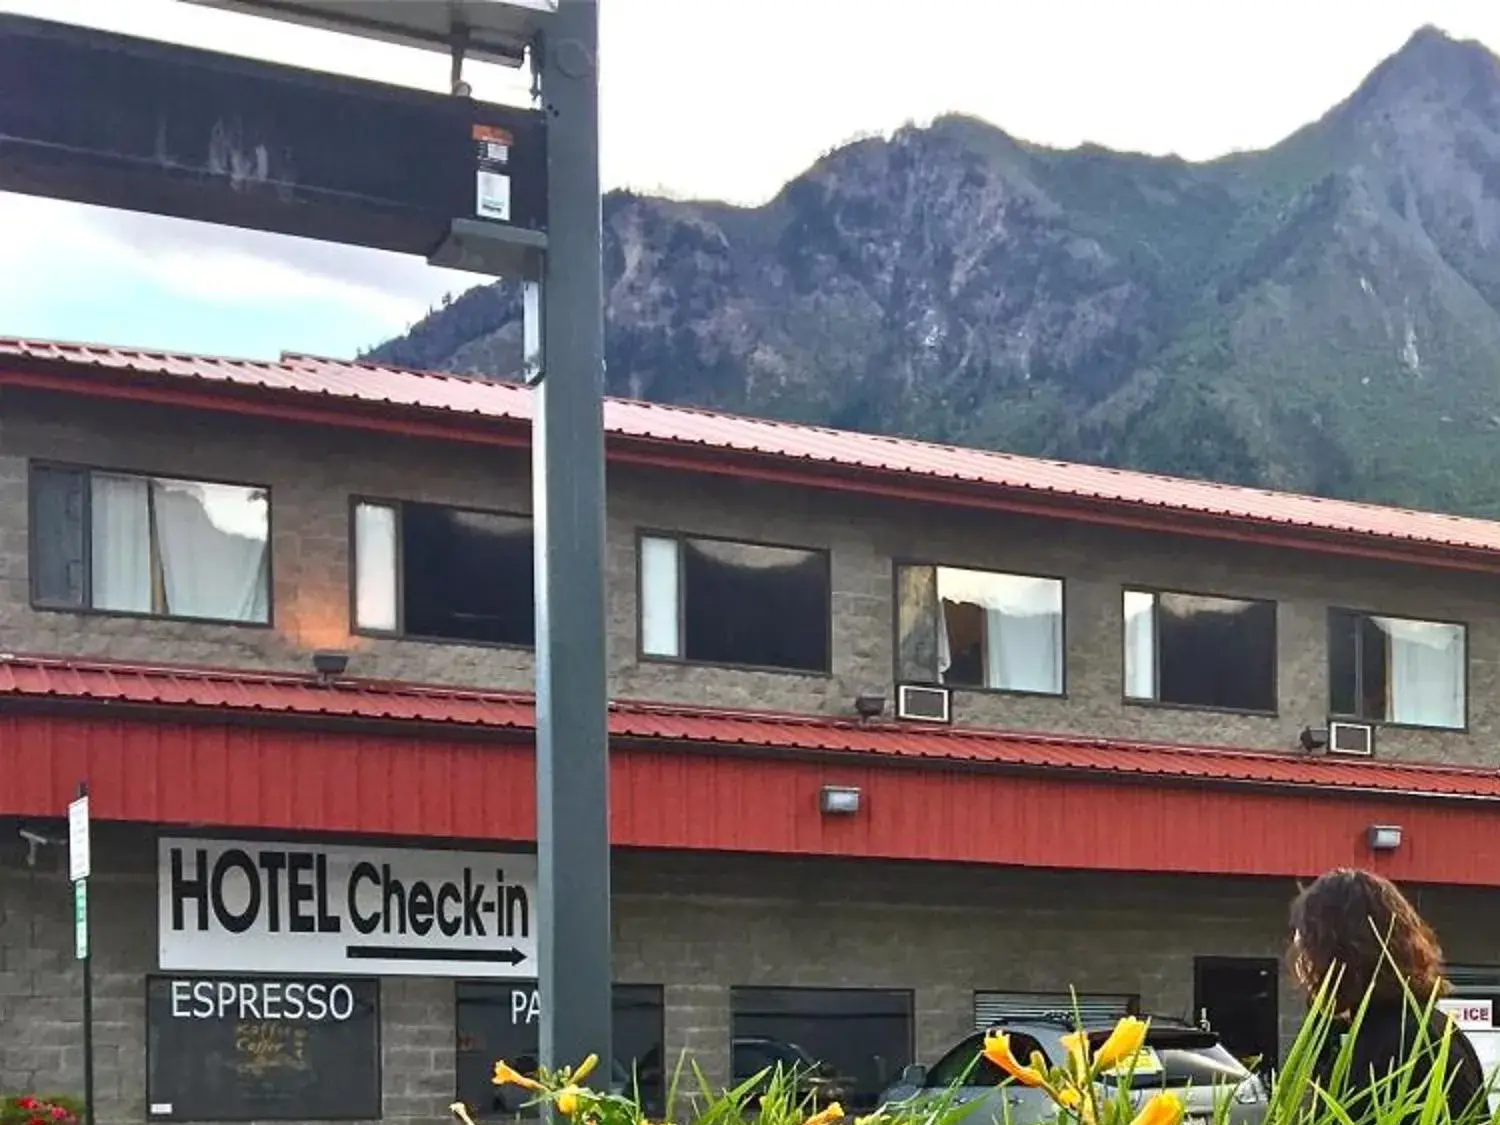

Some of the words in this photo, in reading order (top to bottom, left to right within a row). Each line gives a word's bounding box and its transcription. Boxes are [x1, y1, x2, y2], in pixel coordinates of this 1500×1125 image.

[170, 848, 341, 934] HOTEL
[348, 861, 529, 937] Check-in
[171, 981, 354, 1020] ESPRESSO
[1463, 1007, 1489, 1021] ICE
